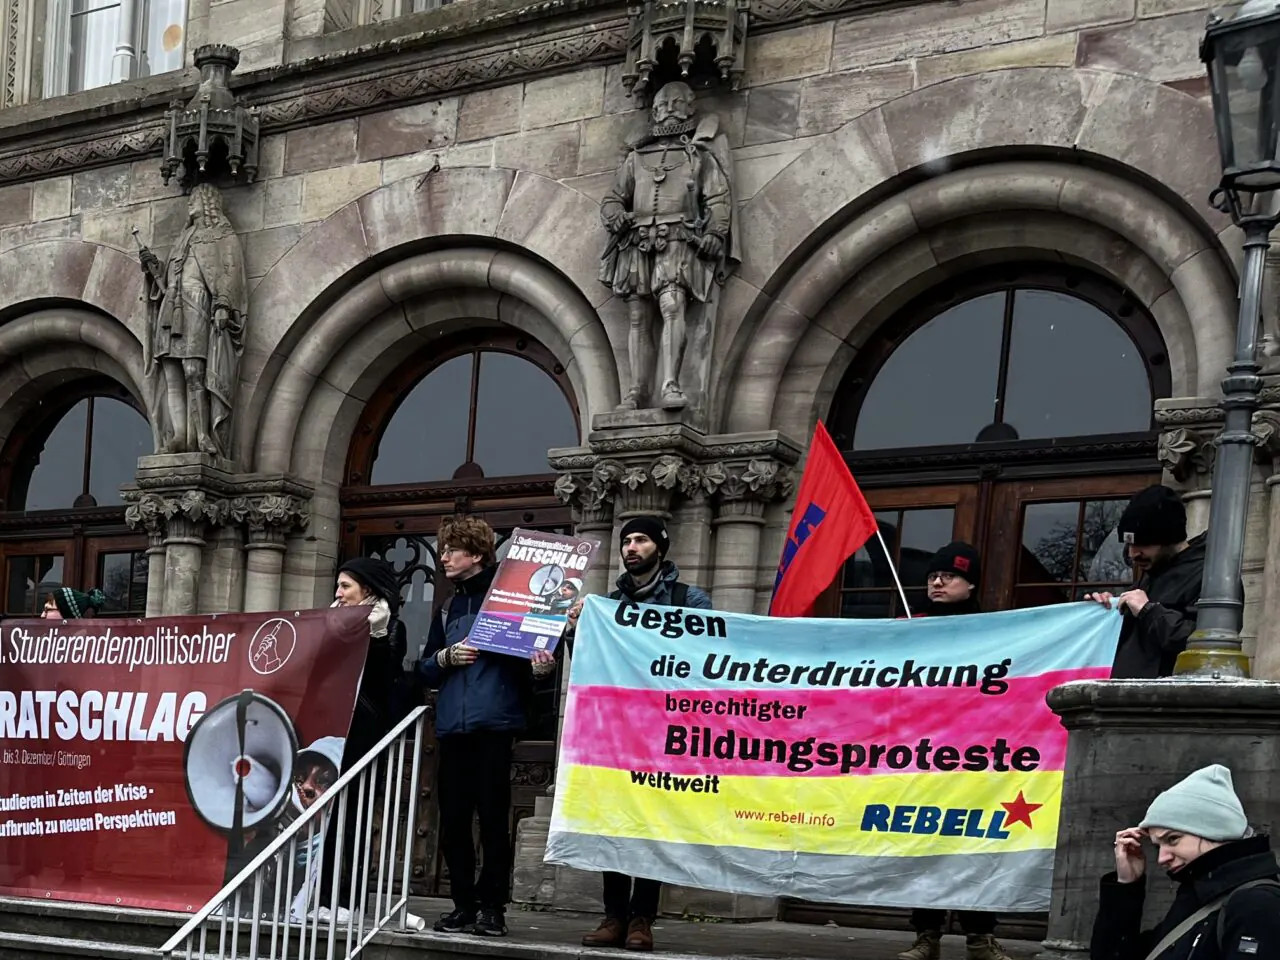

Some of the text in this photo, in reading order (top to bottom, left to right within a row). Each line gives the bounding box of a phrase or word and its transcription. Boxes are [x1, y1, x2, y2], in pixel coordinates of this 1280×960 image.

[506, 544, 589, 571] RATSCHLAG
[613, 600, 728, 639] Gegen
[8, 626, 236, 673] Studierendenpolitischer
[650, 654, 1012, 696] die Unterdrückung
[665, 694, 808, 722] berechtigter
[2, 749, 14, 764] bis
[57, 750, 91, 770] Göttingen
[664, 724, 1042, 774] Bildungsproteste
[630, 769, 720, 794] weltweit
[45, 790, 55, 809] in
[57, 787, 93, 807] Zeiten
[93, 785, 114, 804] der
[114, 782, 147, 802] Krise
[45, 819, 58, 835] zu
[59, 816, 94, 833] neuen
[94, 808, 176, 832] Perspektiven
[734, 807, 836, 828] www.rebell.info
[860, 802, 1011, 840] REBELL
